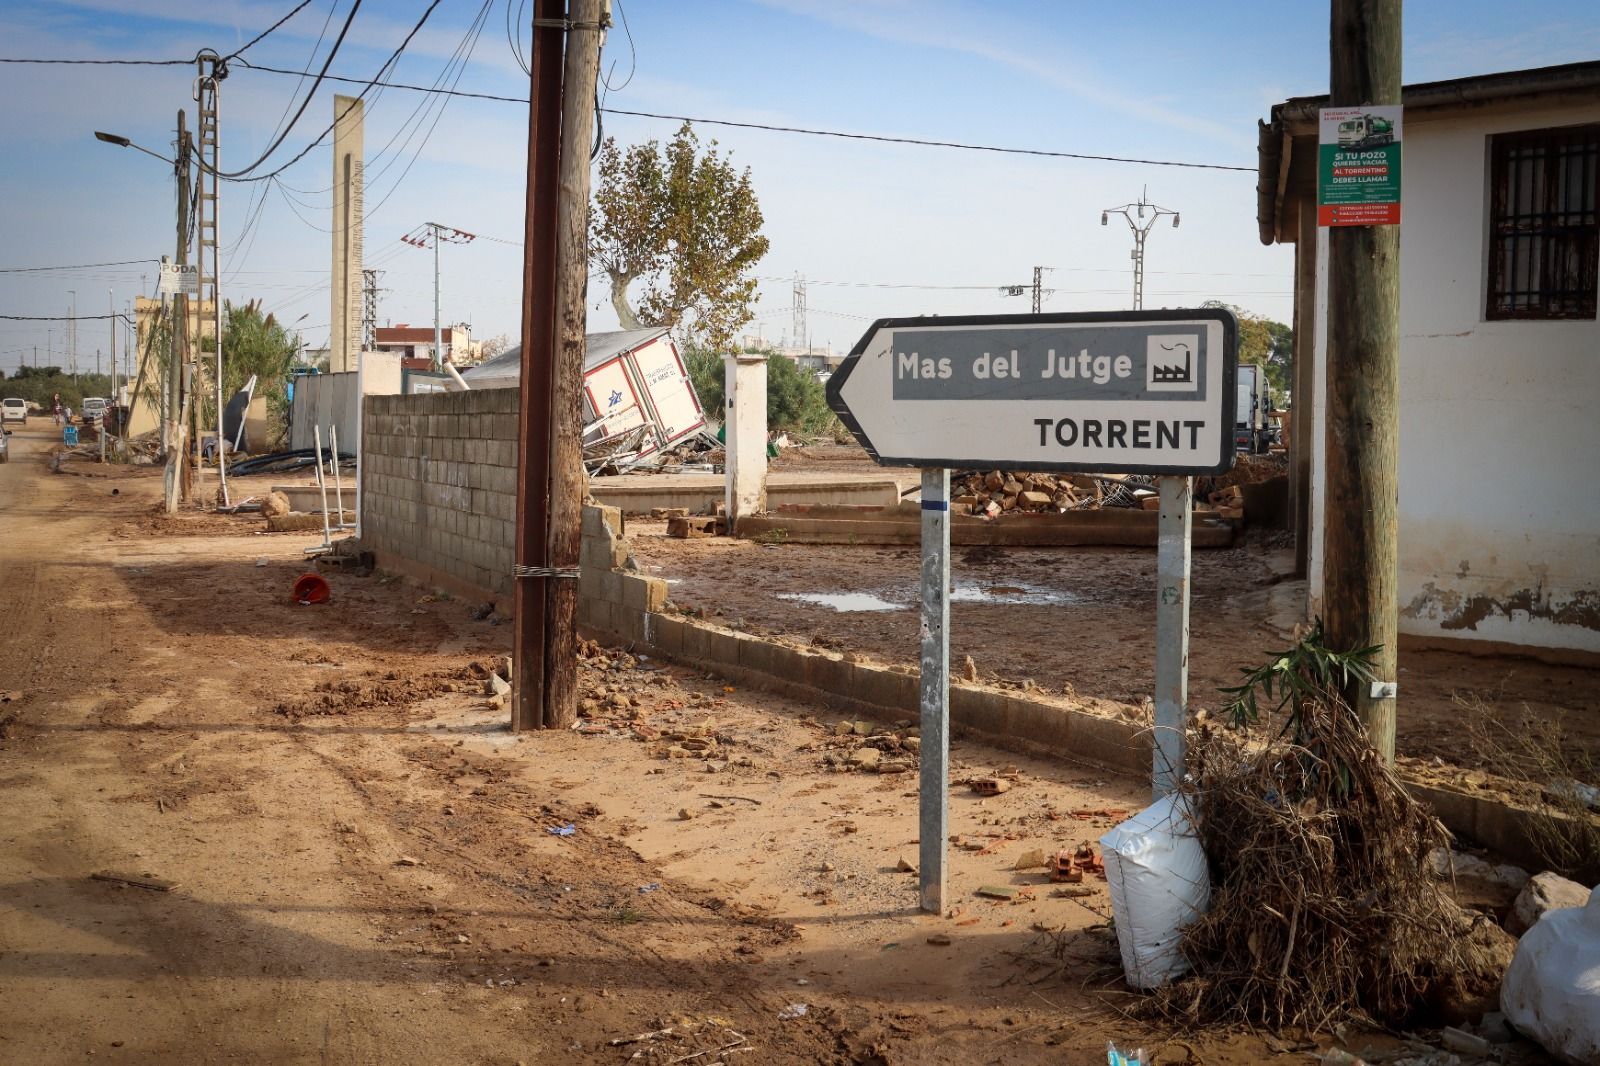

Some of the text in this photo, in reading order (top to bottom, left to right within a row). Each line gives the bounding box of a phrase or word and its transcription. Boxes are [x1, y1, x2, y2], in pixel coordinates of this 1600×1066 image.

[1335, 151, 1386, 160] SI TU POZO
[163, 265, 197, 273] PODA
[898, 349, 1132, 385] Mas del Jutge
[1034, 418, 1205, 450] TORRENT
